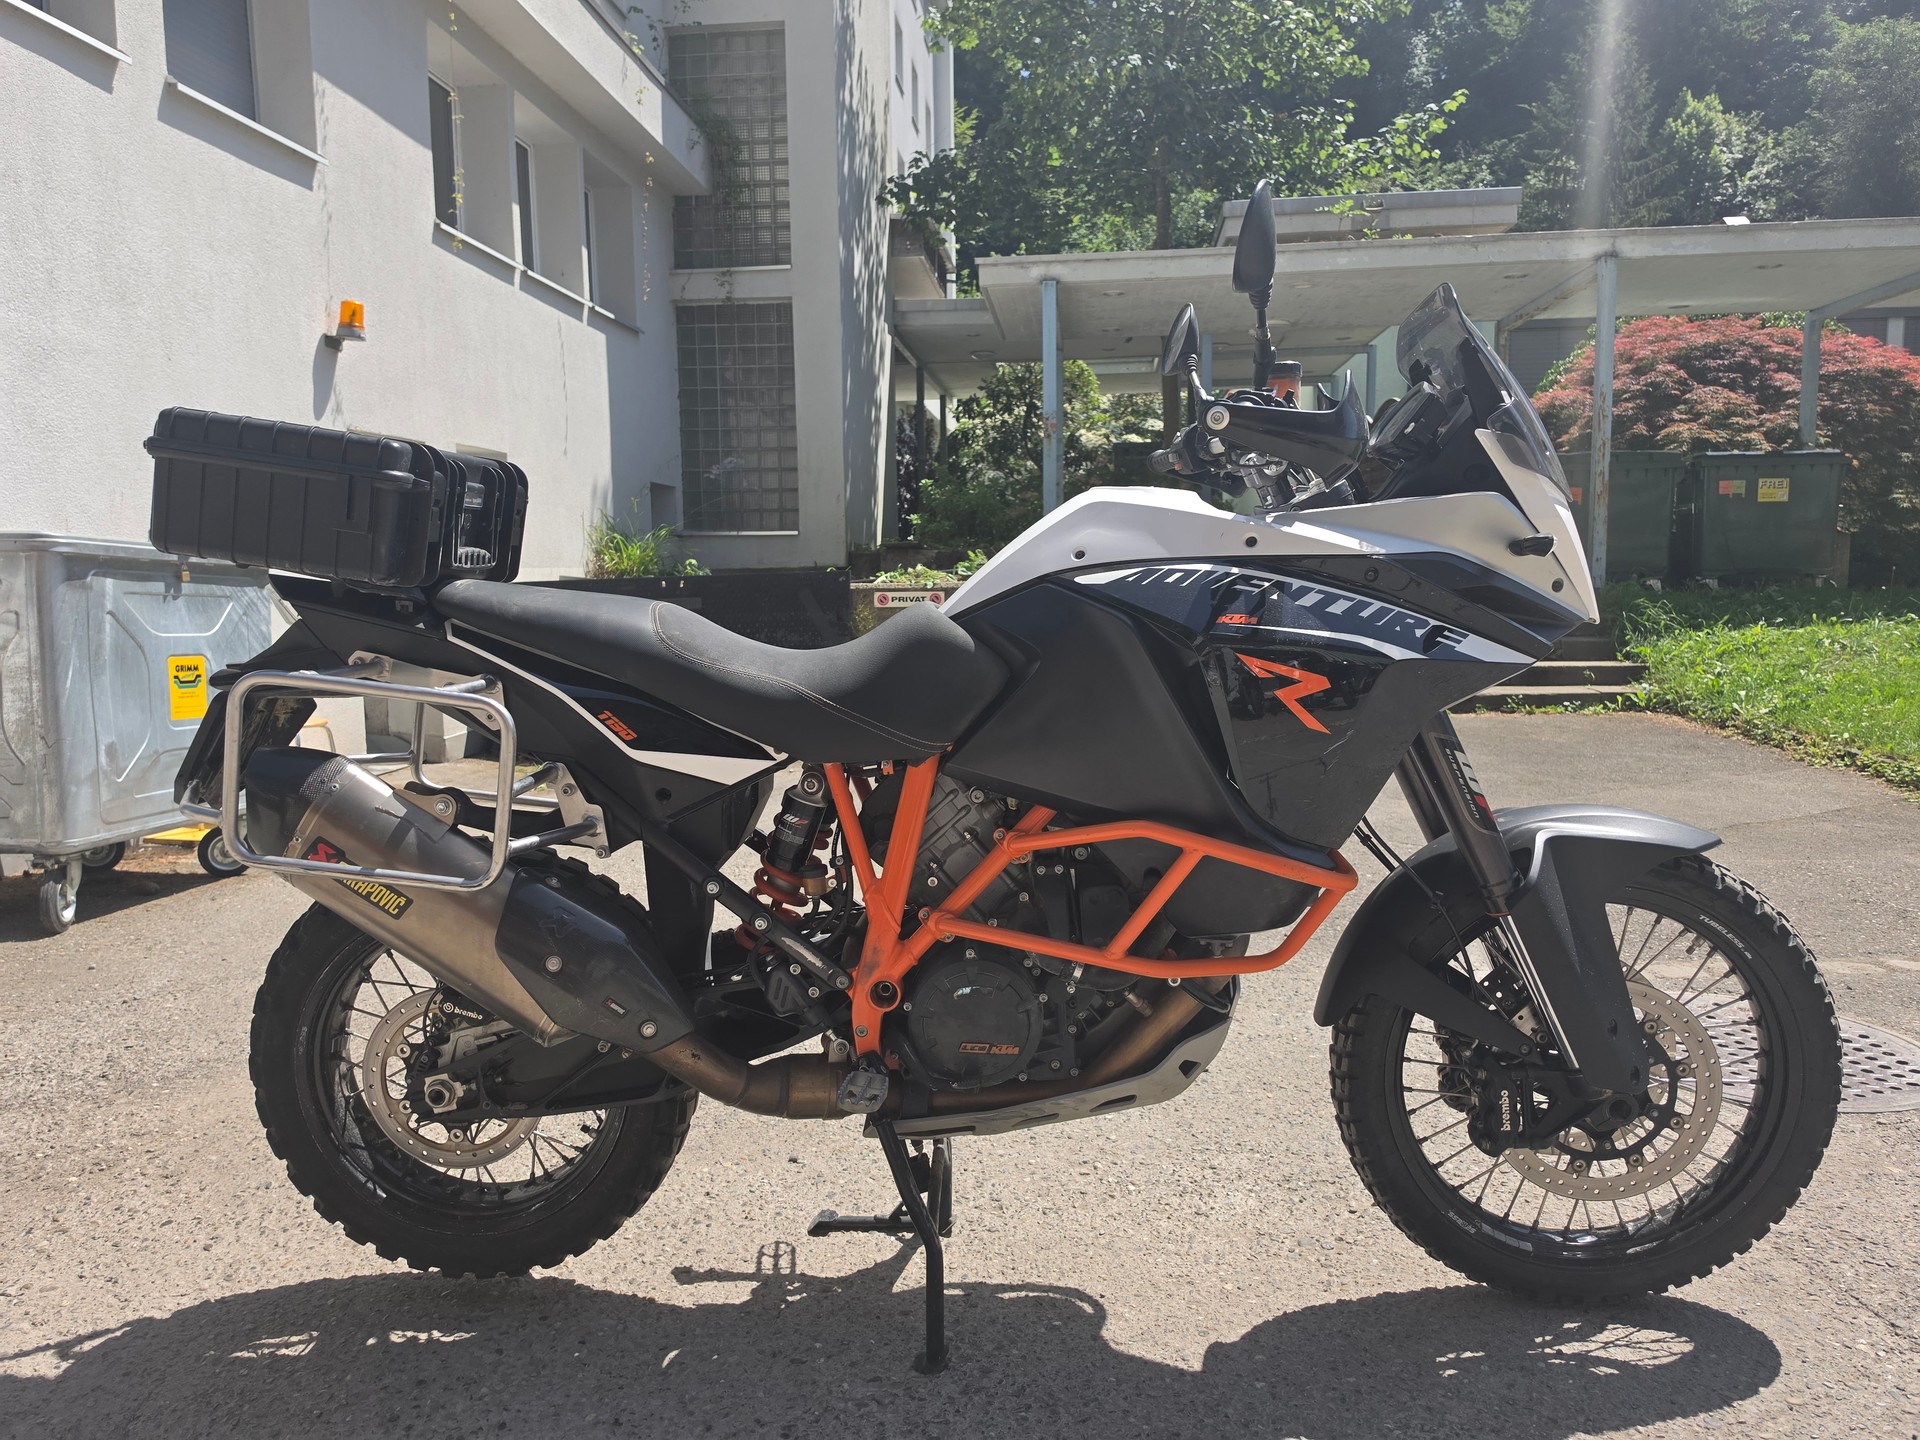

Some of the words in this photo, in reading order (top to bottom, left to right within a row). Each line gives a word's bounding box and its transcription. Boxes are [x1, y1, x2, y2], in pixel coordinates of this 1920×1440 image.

[1760, 479, 1788, 489] FREI
[1106, 567, 1470, 653] ADVENTURE
[1216, 613, 1260, 624] KTM
[175, 664, 200, 673] GRIMM
[1445, 748, 1480, 819] SUSPENSION
[341, 861, 407, 915] APOVIČ
[1699, 914, 1745, 948] TUBELESS
[454, 1006, 483, 1020] brembo
[990, 1044, 1020, 1055] KTM
[1499, 1090, 1511, 1131] brembo
